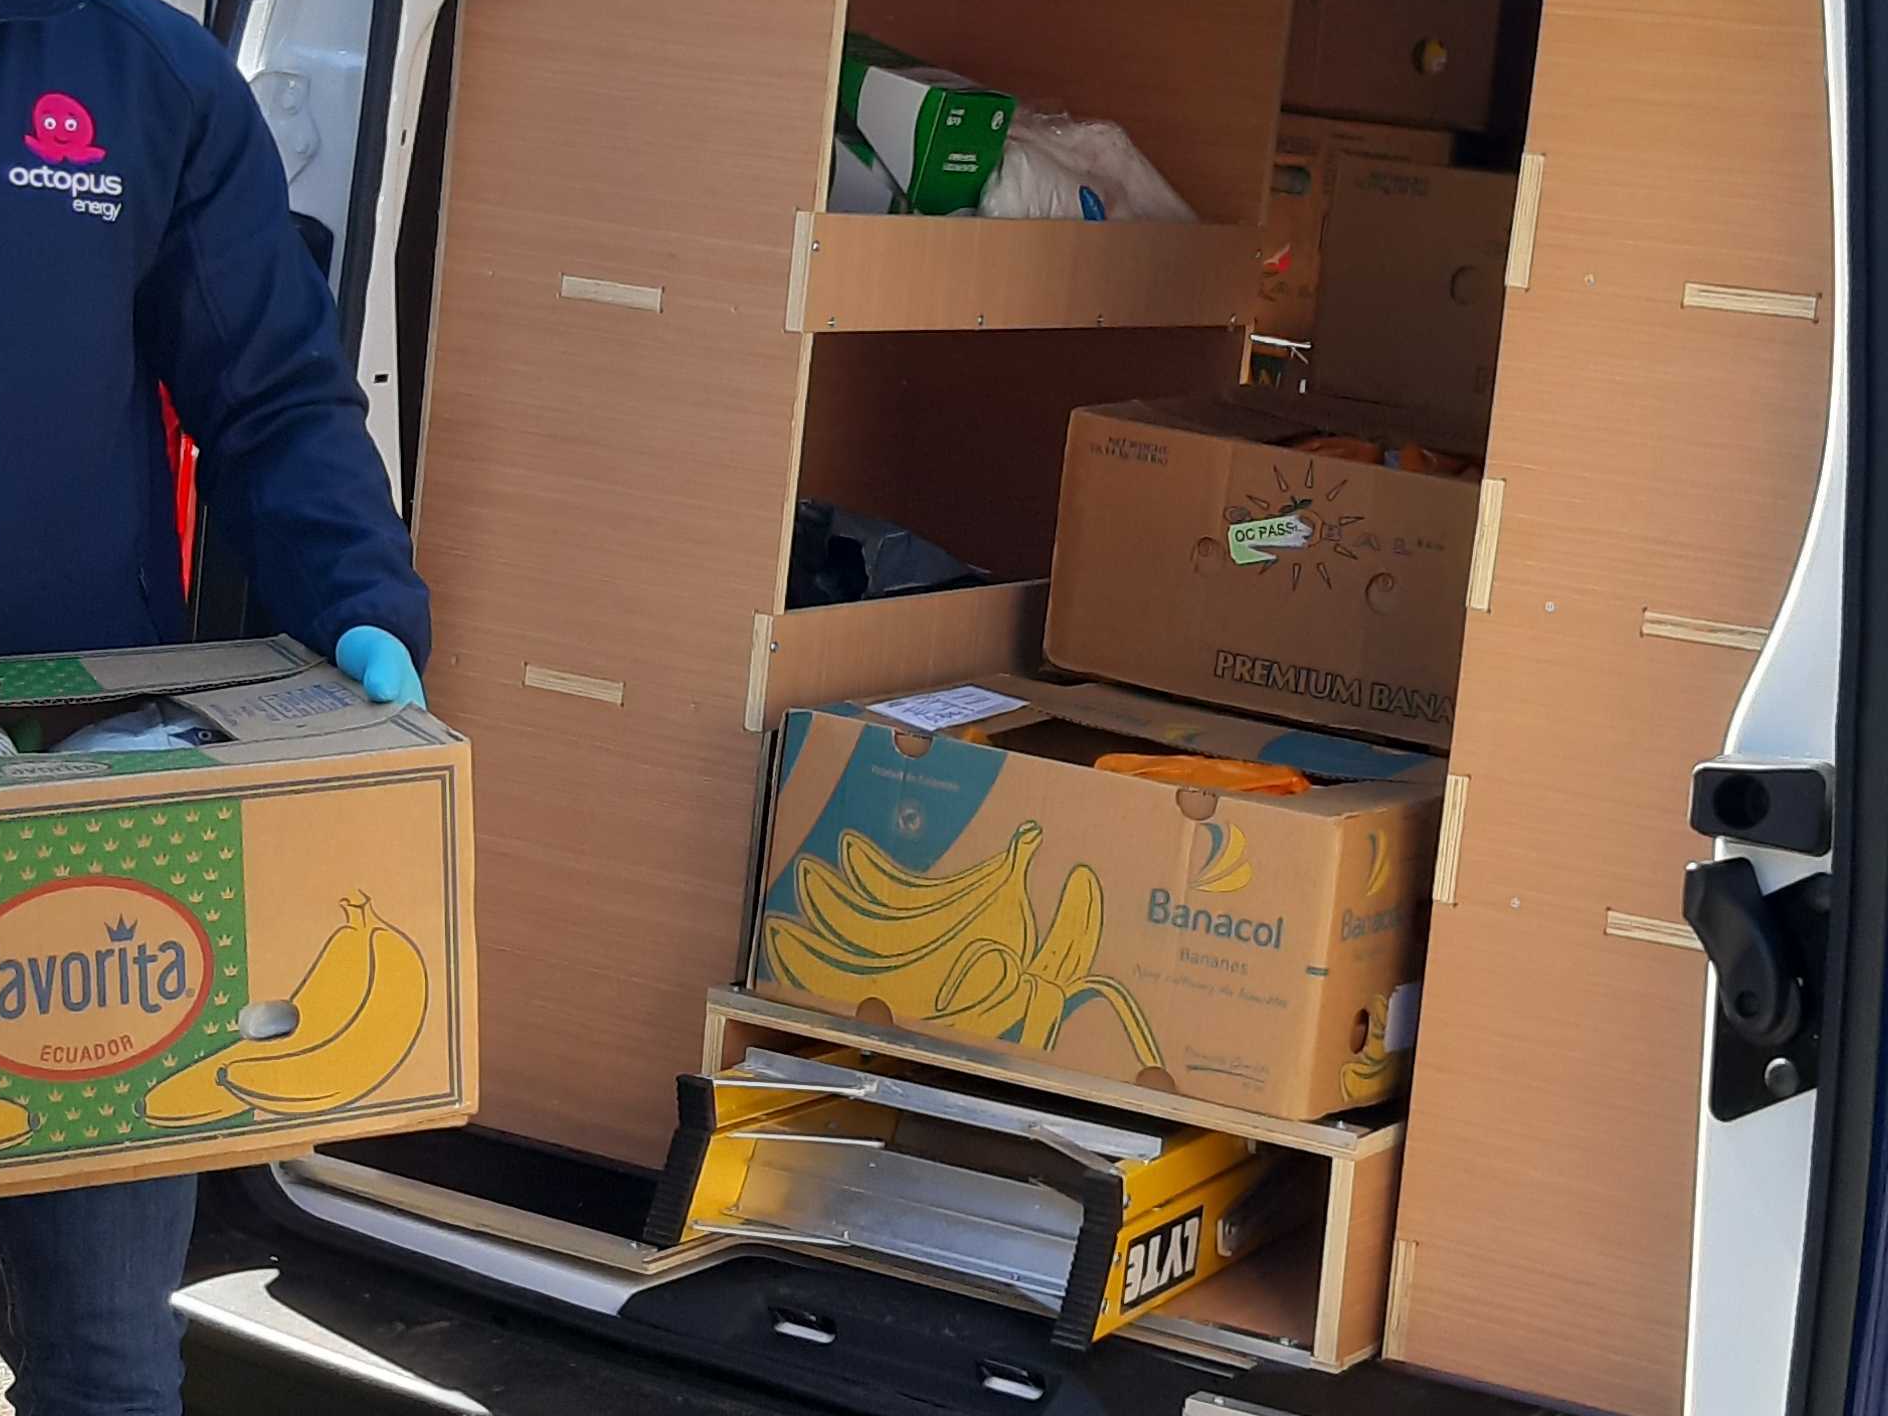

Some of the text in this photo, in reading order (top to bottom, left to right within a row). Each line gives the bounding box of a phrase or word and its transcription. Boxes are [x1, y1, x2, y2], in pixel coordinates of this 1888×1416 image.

[9, 165, 122, 198] octopus
[72, 198, 122, 221] energy
[1215, 650, 1361, 707] PREMIUM
[1148, 888, 1284, 949] Banacol
[40, 1034, 134, 1064] ECUADOR
[1123, 1216, 1200, 1305] LYTE
